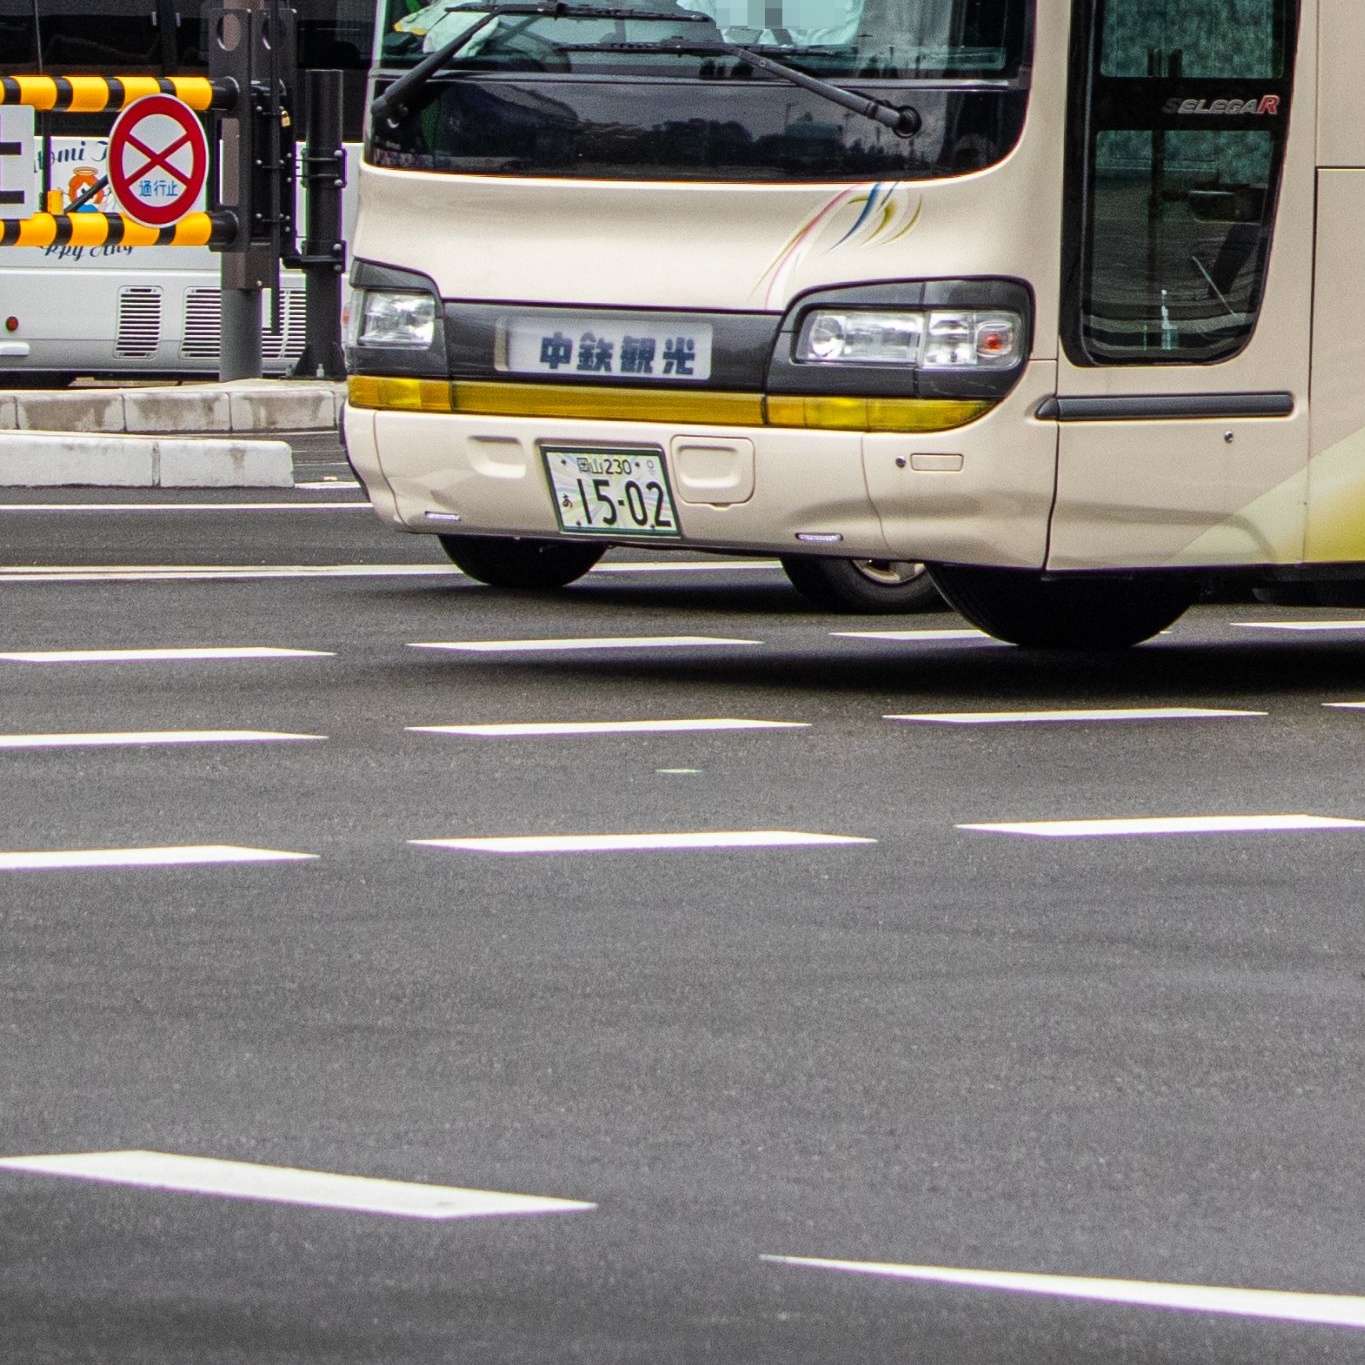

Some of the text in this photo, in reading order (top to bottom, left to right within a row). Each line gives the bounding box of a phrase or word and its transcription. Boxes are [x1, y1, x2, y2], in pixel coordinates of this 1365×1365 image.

[139, 179, 179, 197] 通行止
[539, 330, 697, 376] 中鉄観光
